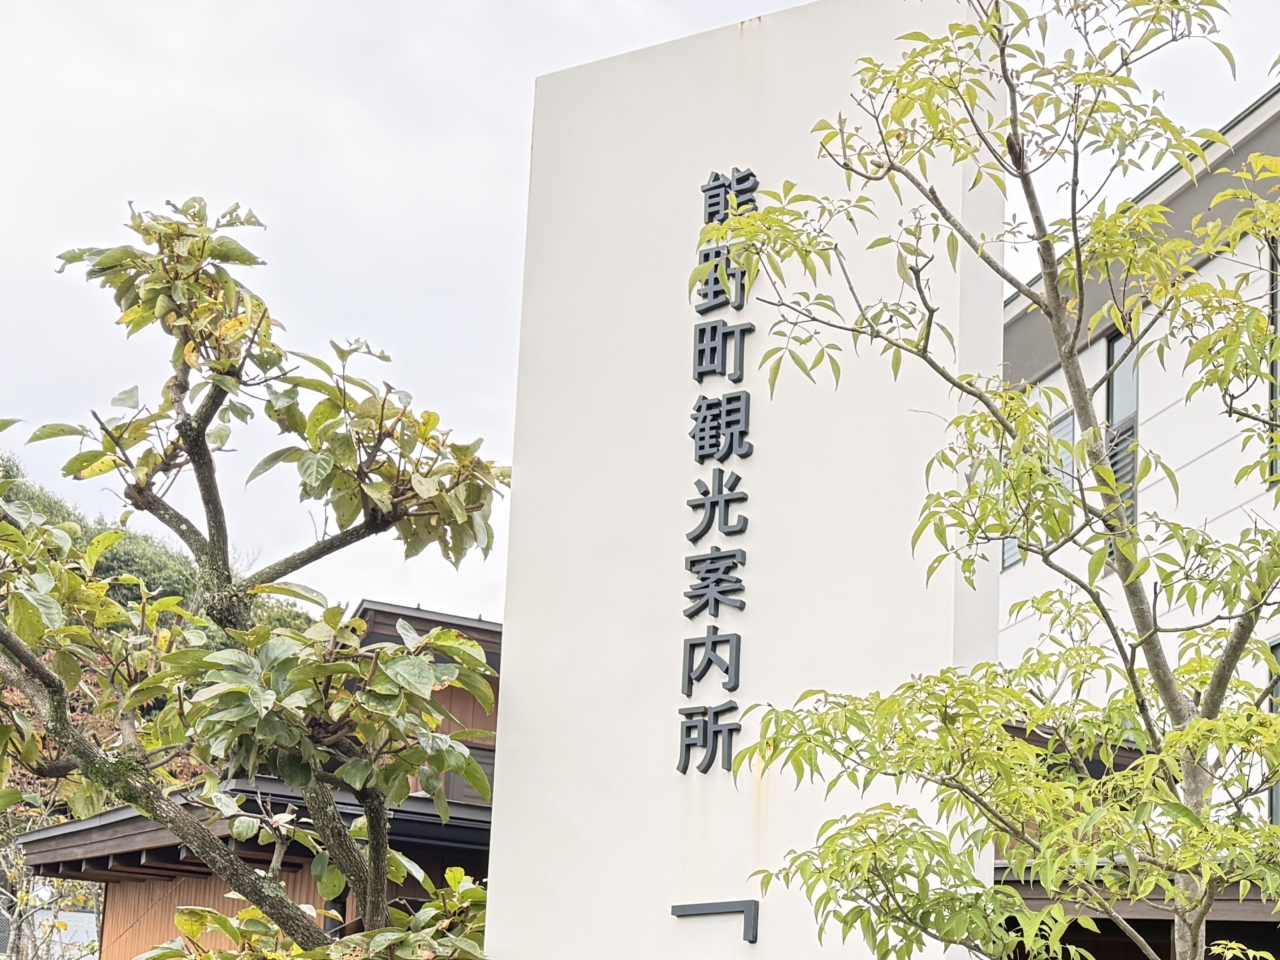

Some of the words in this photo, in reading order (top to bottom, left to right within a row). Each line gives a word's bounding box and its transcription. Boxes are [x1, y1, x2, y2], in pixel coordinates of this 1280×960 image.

[677, 168, 760, 775] 熊野町観光案内所
